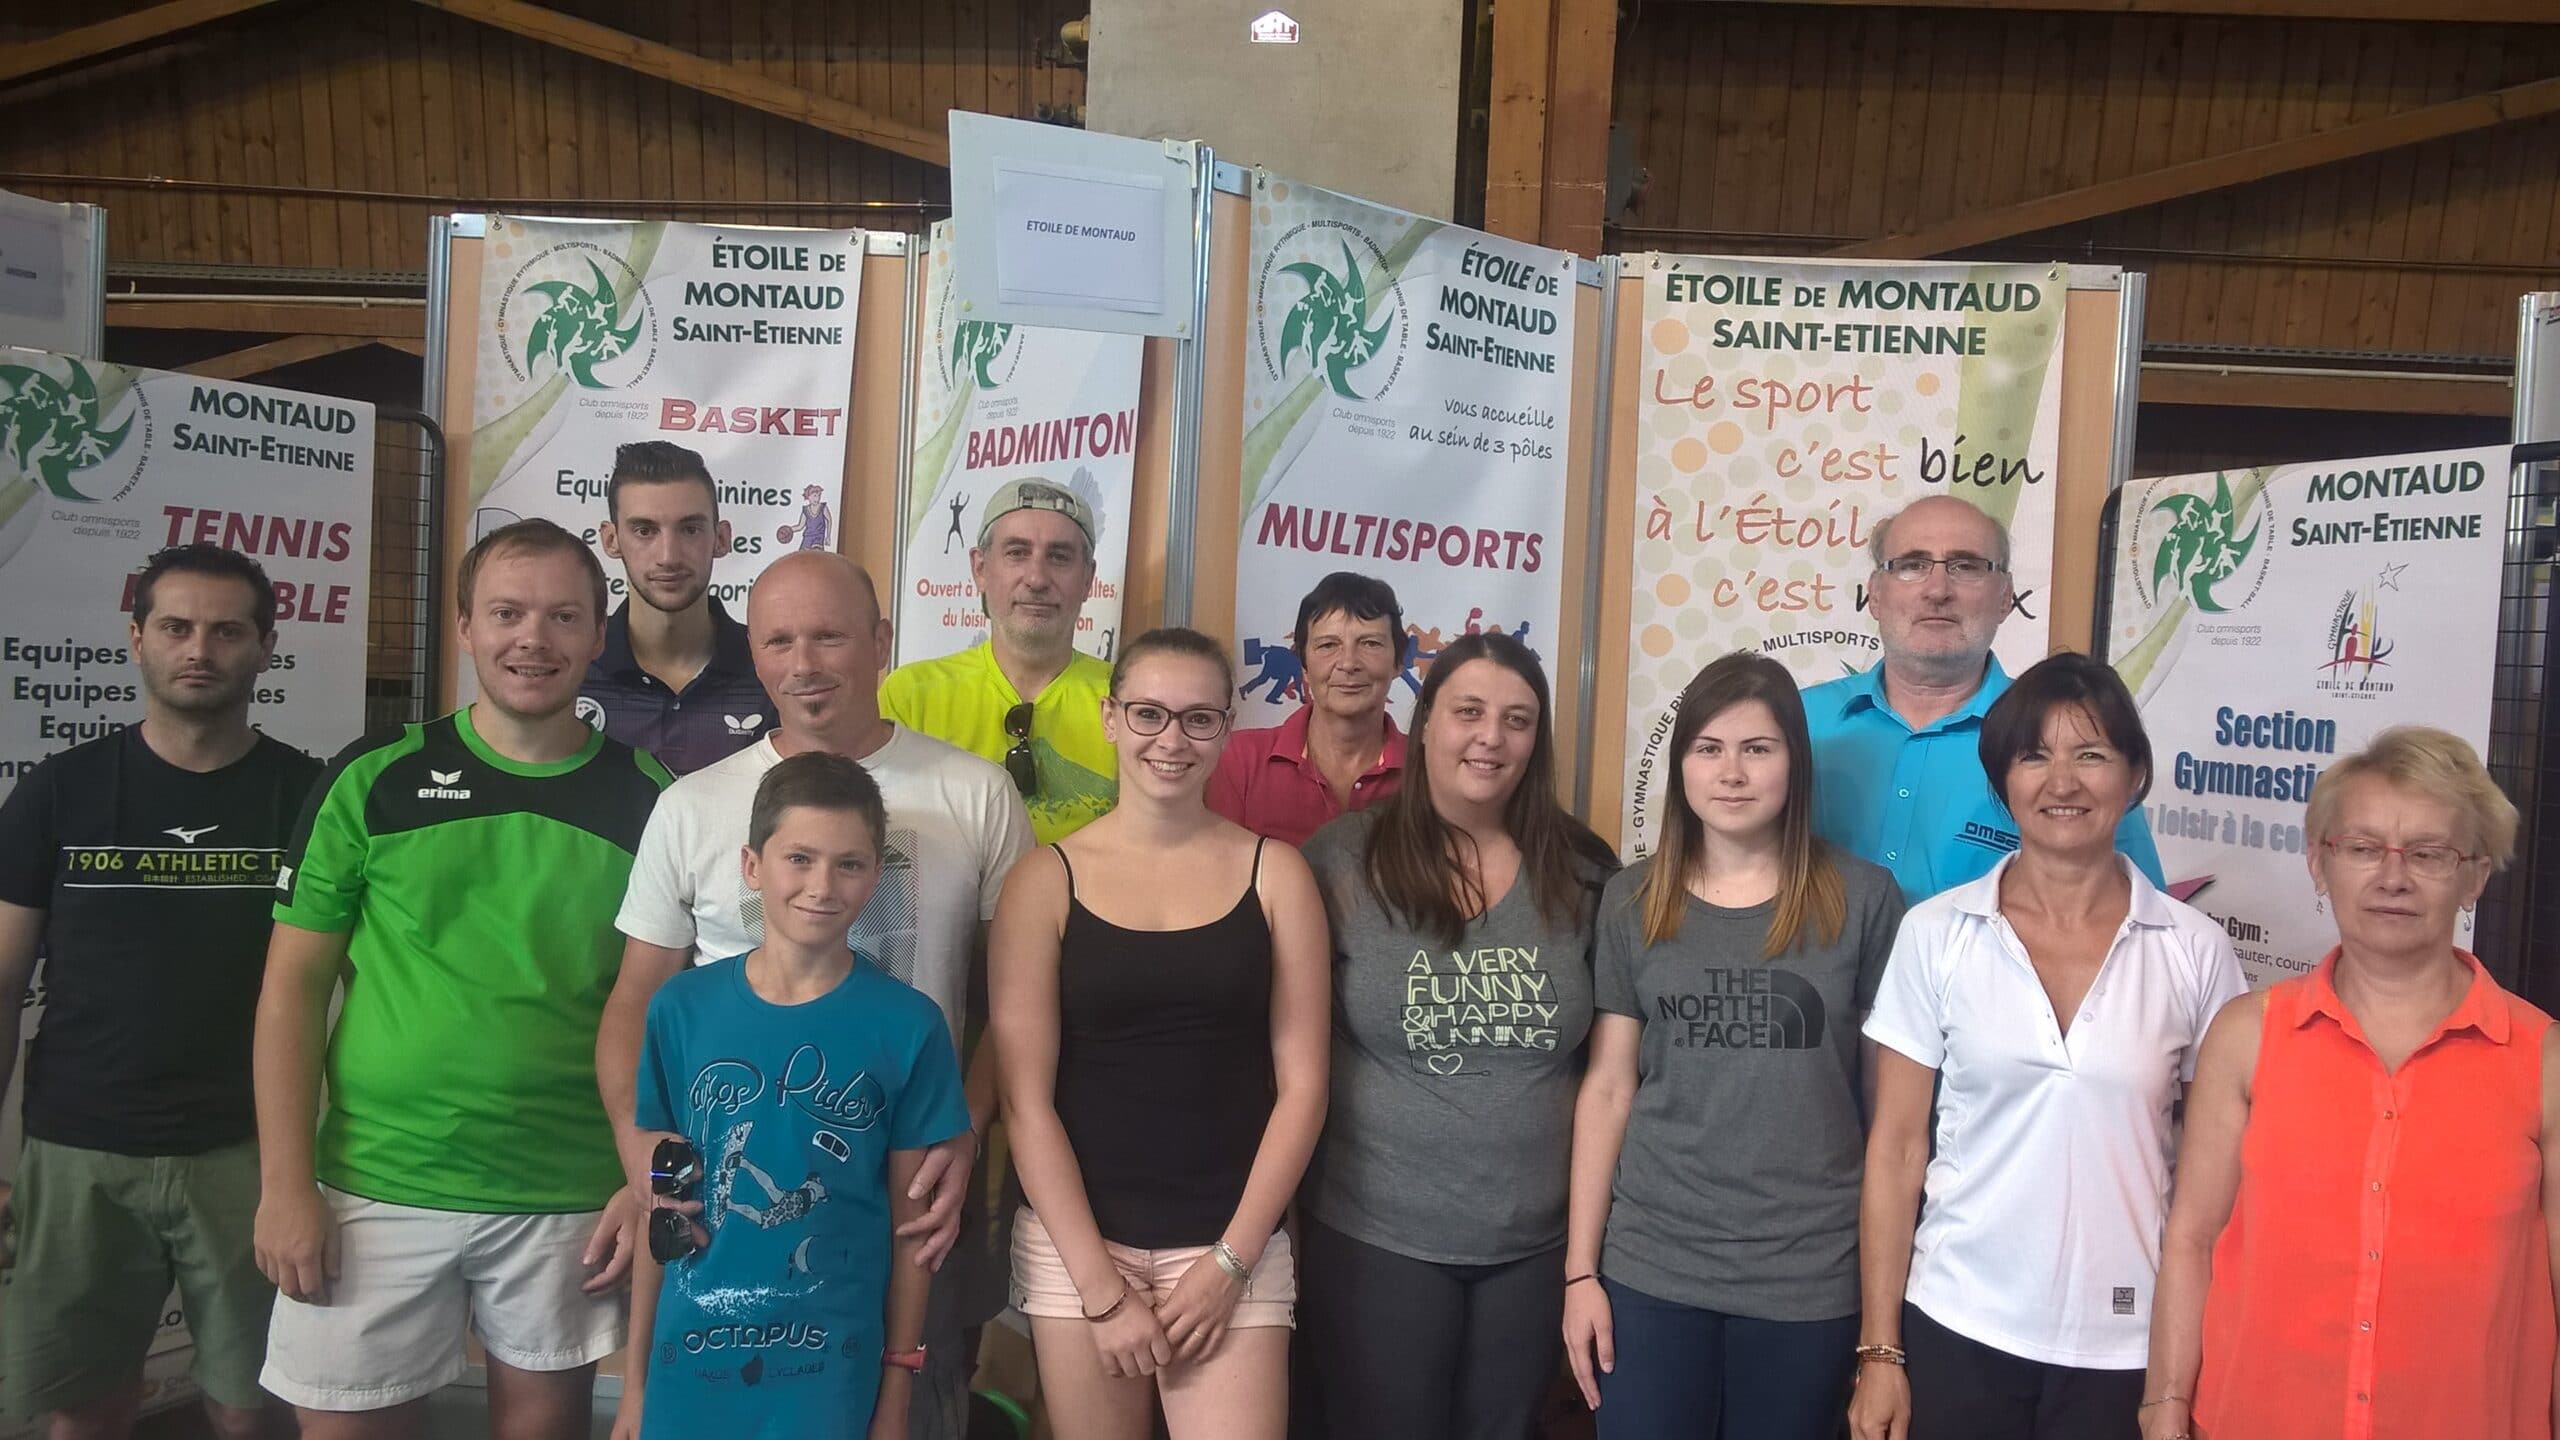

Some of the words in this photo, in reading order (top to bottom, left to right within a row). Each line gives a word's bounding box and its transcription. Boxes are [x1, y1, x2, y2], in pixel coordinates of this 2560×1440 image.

[1026, 220, 1063, 234] ETOILE
[1065, 224, 1079, 235] DE
[1081, 226, 1136, 242] MONTAUD
[1311, 219, 1361, 237] MULTISPORTS
[712, 235, 808, 272] ÉTOILE
[820, 254, 846, 272] DE
[1460, 241, 1535, 291] ÉTOILE
[1535, 276, 1558, 297] DE
[684, 281, 845, 311] MONTAUD
[1665, 263, 1782, 307] ÉTOILE
[1794, 287, 1826, 308] DE
[1837, 280, 2042, 312] MONTAUD
[1440, 285, 1557, 336] MONTAUD
[672, 317, 843, 345] SAINT-ETIENNE
[1426, 322, 1556, 374] SAINT-ETIENNE
[1712, 319, 1987, 355] SAINT-ETIENNE
[189, 386, 356, 434] MONTAUD
[659, 397, 843, 437] BASKET
[1332, 407, 1352, 419] Club
[1353, 412, 1396, 428] omnisports
[1482, 405, 1555, 430] accueille
[1654, 368, 1716, 410] Le
[1732, 374, 1874, 431] sport
[173, 423, 354, 472] SAINT-ETIENNE
[966, 409, 1136, 470] BADMINTON
[1409, 425, 1434, 442] au
[1438, 426, 1470, 448] sein
[1473, 432, 1490, 453] de
[1493, 440, 1506, 453] 3
[1511, 437, 1553, 463] pôles
[1776, 441, 1900, 483] c'est
[1920, 435, 2044, 487] bien
[557, 470, 609, 504] Equi
[718, 479, 792, 506] inines
[2306, 460, 2485, 504] MONTAUD
[81, 514, 140, 528] omnisports
[162, 505, 352, 562] TENNIS
[1257, 502, 1543, 574] MULTISPORTS
[1646, 495, 1672, 541] à
[1696, 494, 1870, 549] l'Étoil
[2290, 513, 2482, 548] SAINT-ETIENNE
[916, 578, 962, 596] Ouvert
[965, 582, 973, 596] à
[1712, 570, 1836, 613] c'est
[943, 608, 957, 626] du
[2327, 589, 2352, 650] GYMNASTIQUE
[3, 637, 128, 671] Equipes
[1762, 631, 1880, 652] MULTISPORTS
[13, 676, 137, 709] Equipes
[2215, 706, 2336, 753] Section
[1632, 711, 1675, 829] GYMNASTIQUE
[2174, 751, 2327, 803] Gymnasti
[417, 786, 471, 800] erima
[2158, 803, 2219, 841] loisir
[2222, 810, 2237, 844] à
[2241, 814, 2264, 849] la
[67, 852, 124, 871] 1906
[136, 853, 259, 872] ATHLETIC
[2227, 916, 2260, 942] Gym
[1407, 949, 1432, 974] A
[1452, 947, 1538, 974] VERY
[1408, 974, 1546, 1004] FUNNY
[1704, 968, 1768, 994] THE
[1657, 995, 1768, 1021] NORTH
[1407, 1026, 1557, 1051] RUNNING
[1689, 1022, 1767, 1049] FACE
